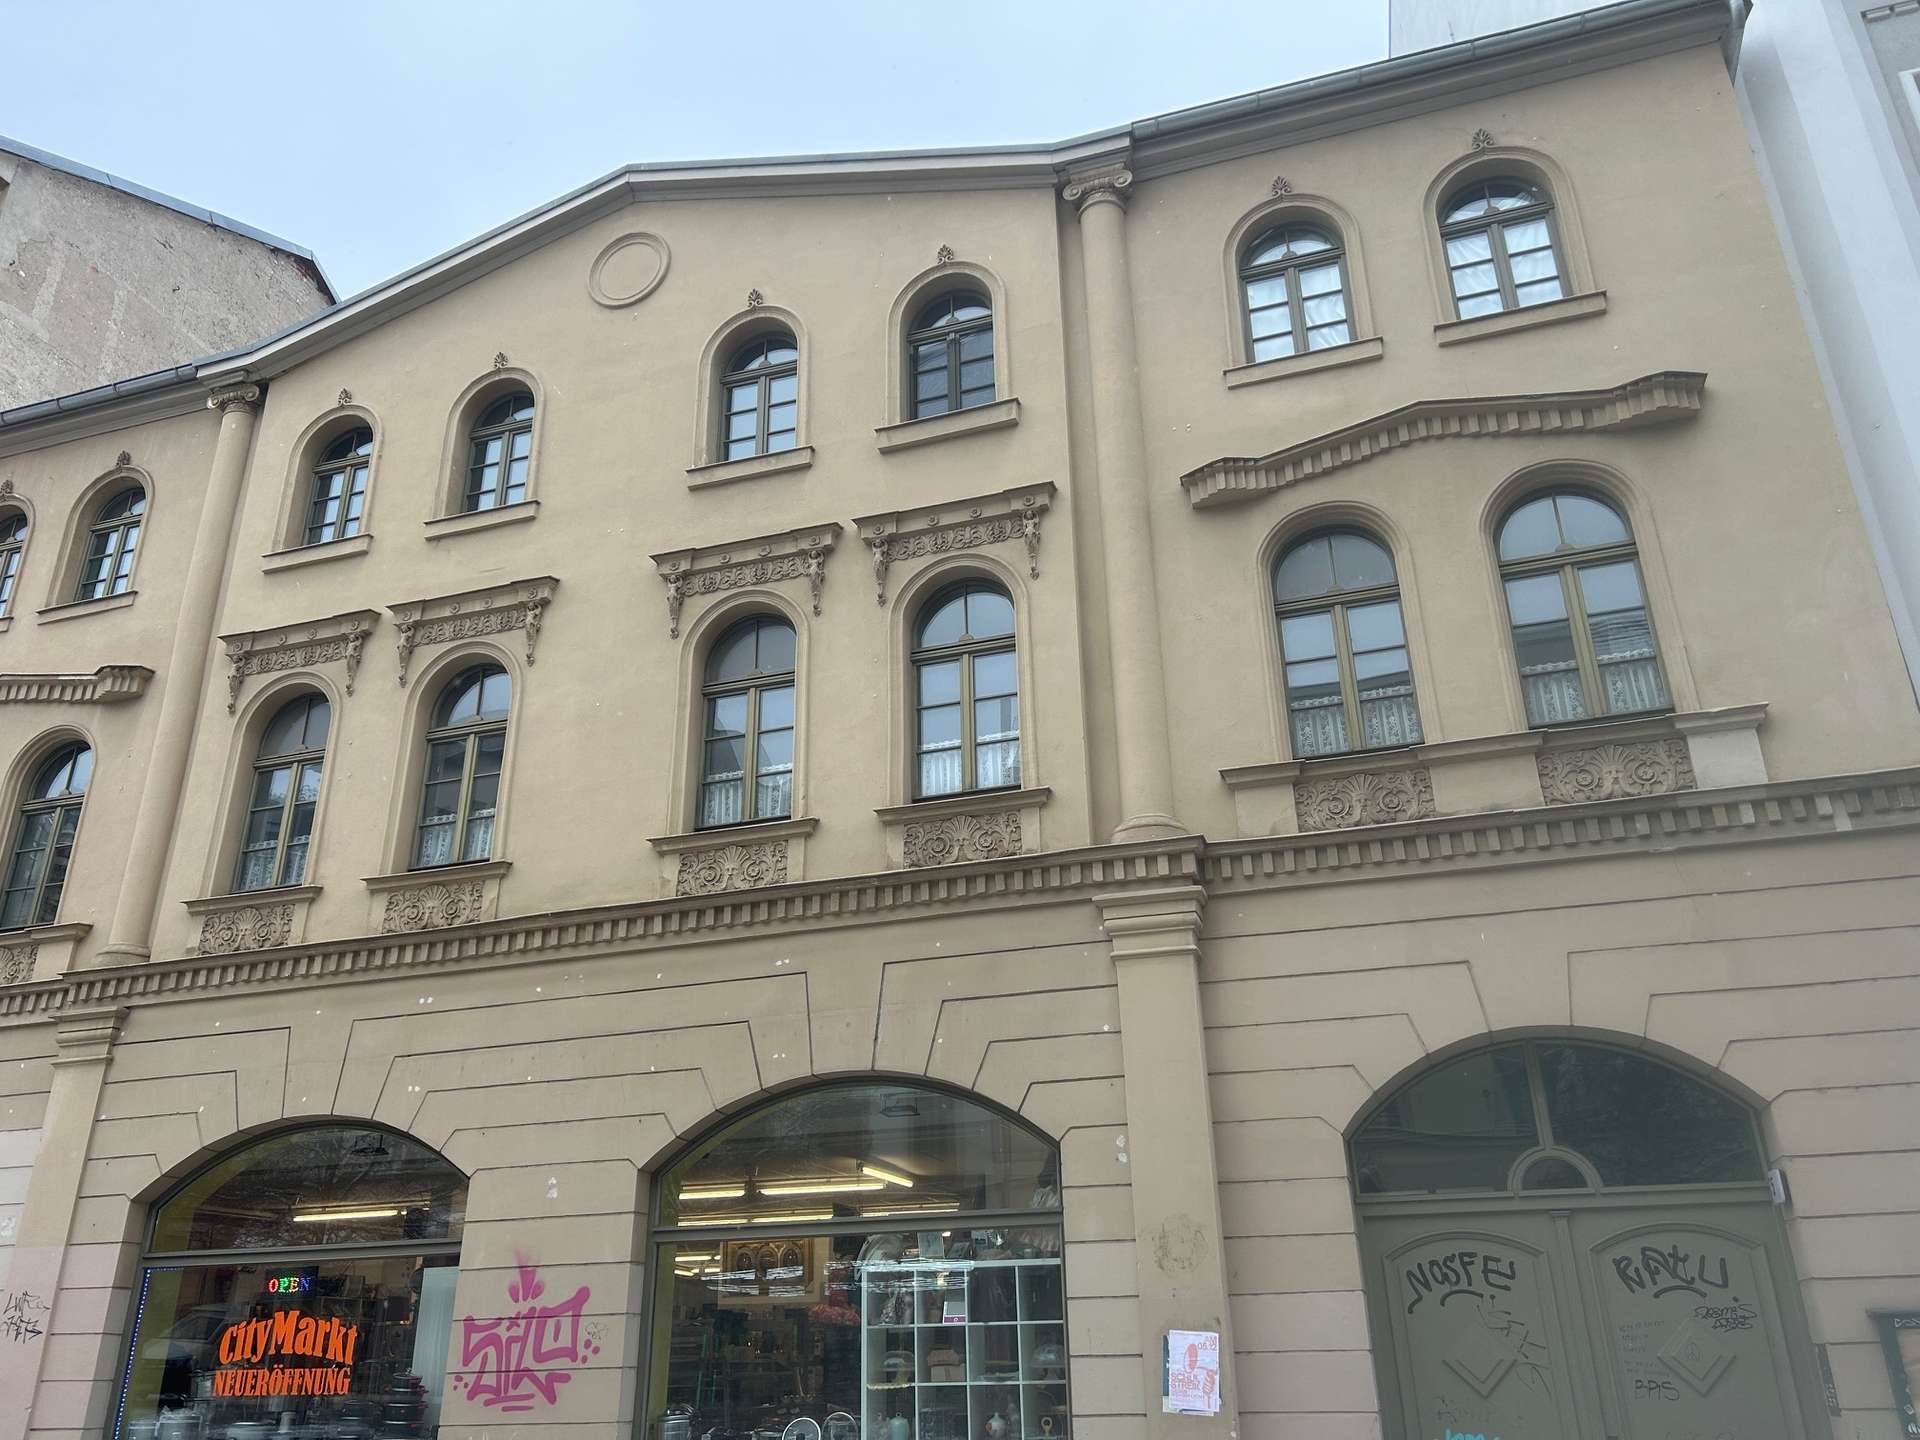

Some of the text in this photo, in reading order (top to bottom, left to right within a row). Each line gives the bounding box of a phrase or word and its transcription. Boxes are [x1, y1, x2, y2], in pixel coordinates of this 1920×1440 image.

[268, 1277, 311, 1293] OPEN
[219, 1310, 358, 1365] CityMarkt
[213, 1364, 351, 1397] NEUERÖFFNUNG
